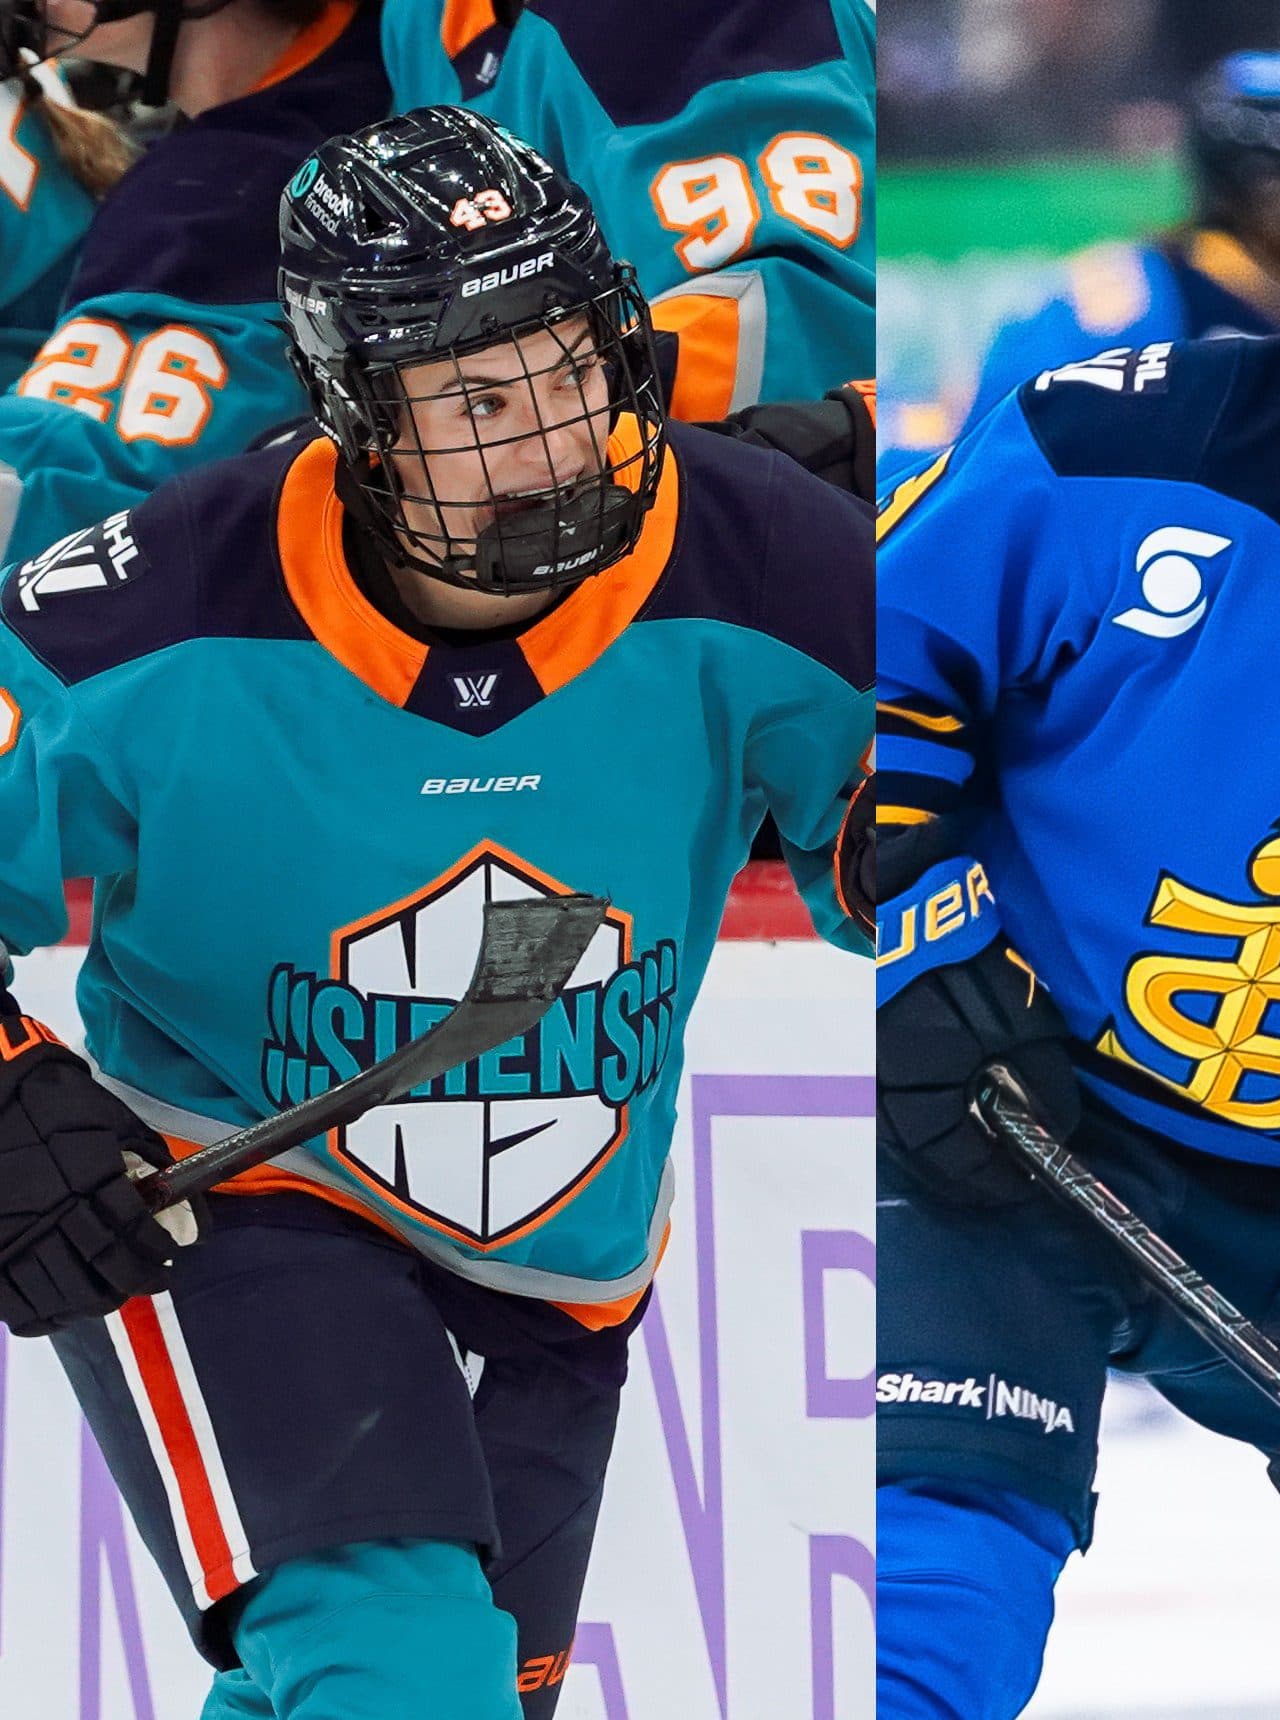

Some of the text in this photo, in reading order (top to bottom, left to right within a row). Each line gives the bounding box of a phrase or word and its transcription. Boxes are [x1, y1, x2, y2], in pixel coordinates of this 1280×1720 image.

[449, 188, 513, 232] 43
[649, 131, 863, 275] 98
[17, 316, 229, 447] 26
[876, 1373, 1075, 1434] Shark NINJA
